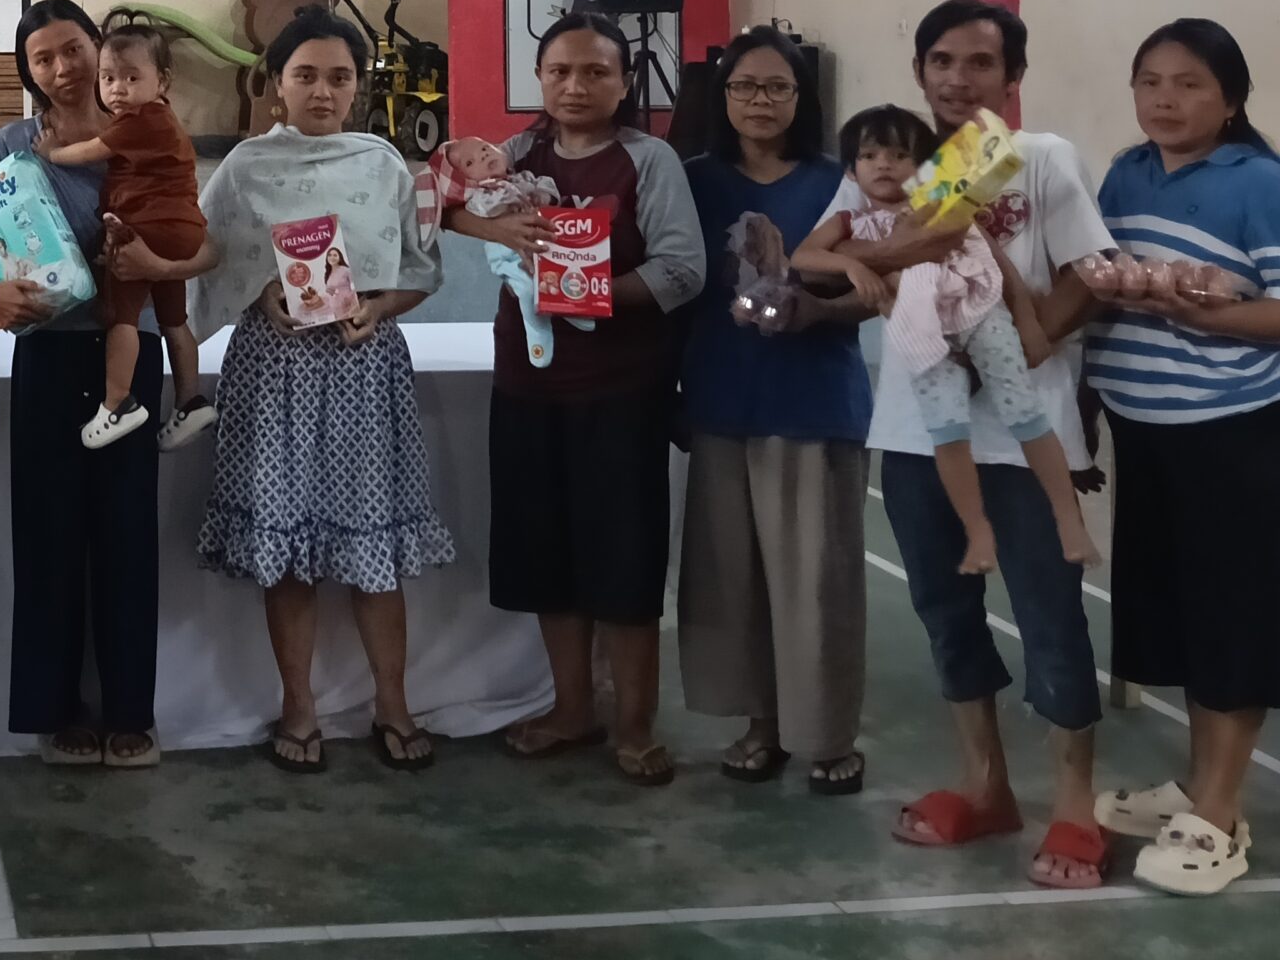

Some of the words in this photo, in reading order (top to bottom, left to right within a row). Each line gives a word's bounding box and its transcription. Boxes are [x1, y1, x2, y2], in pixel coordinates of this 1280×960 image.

[554, 218, 593, 236] SGM
[281, 230, 331, 248] PRENAGEN
[295, 244, 320, 254] mommy
